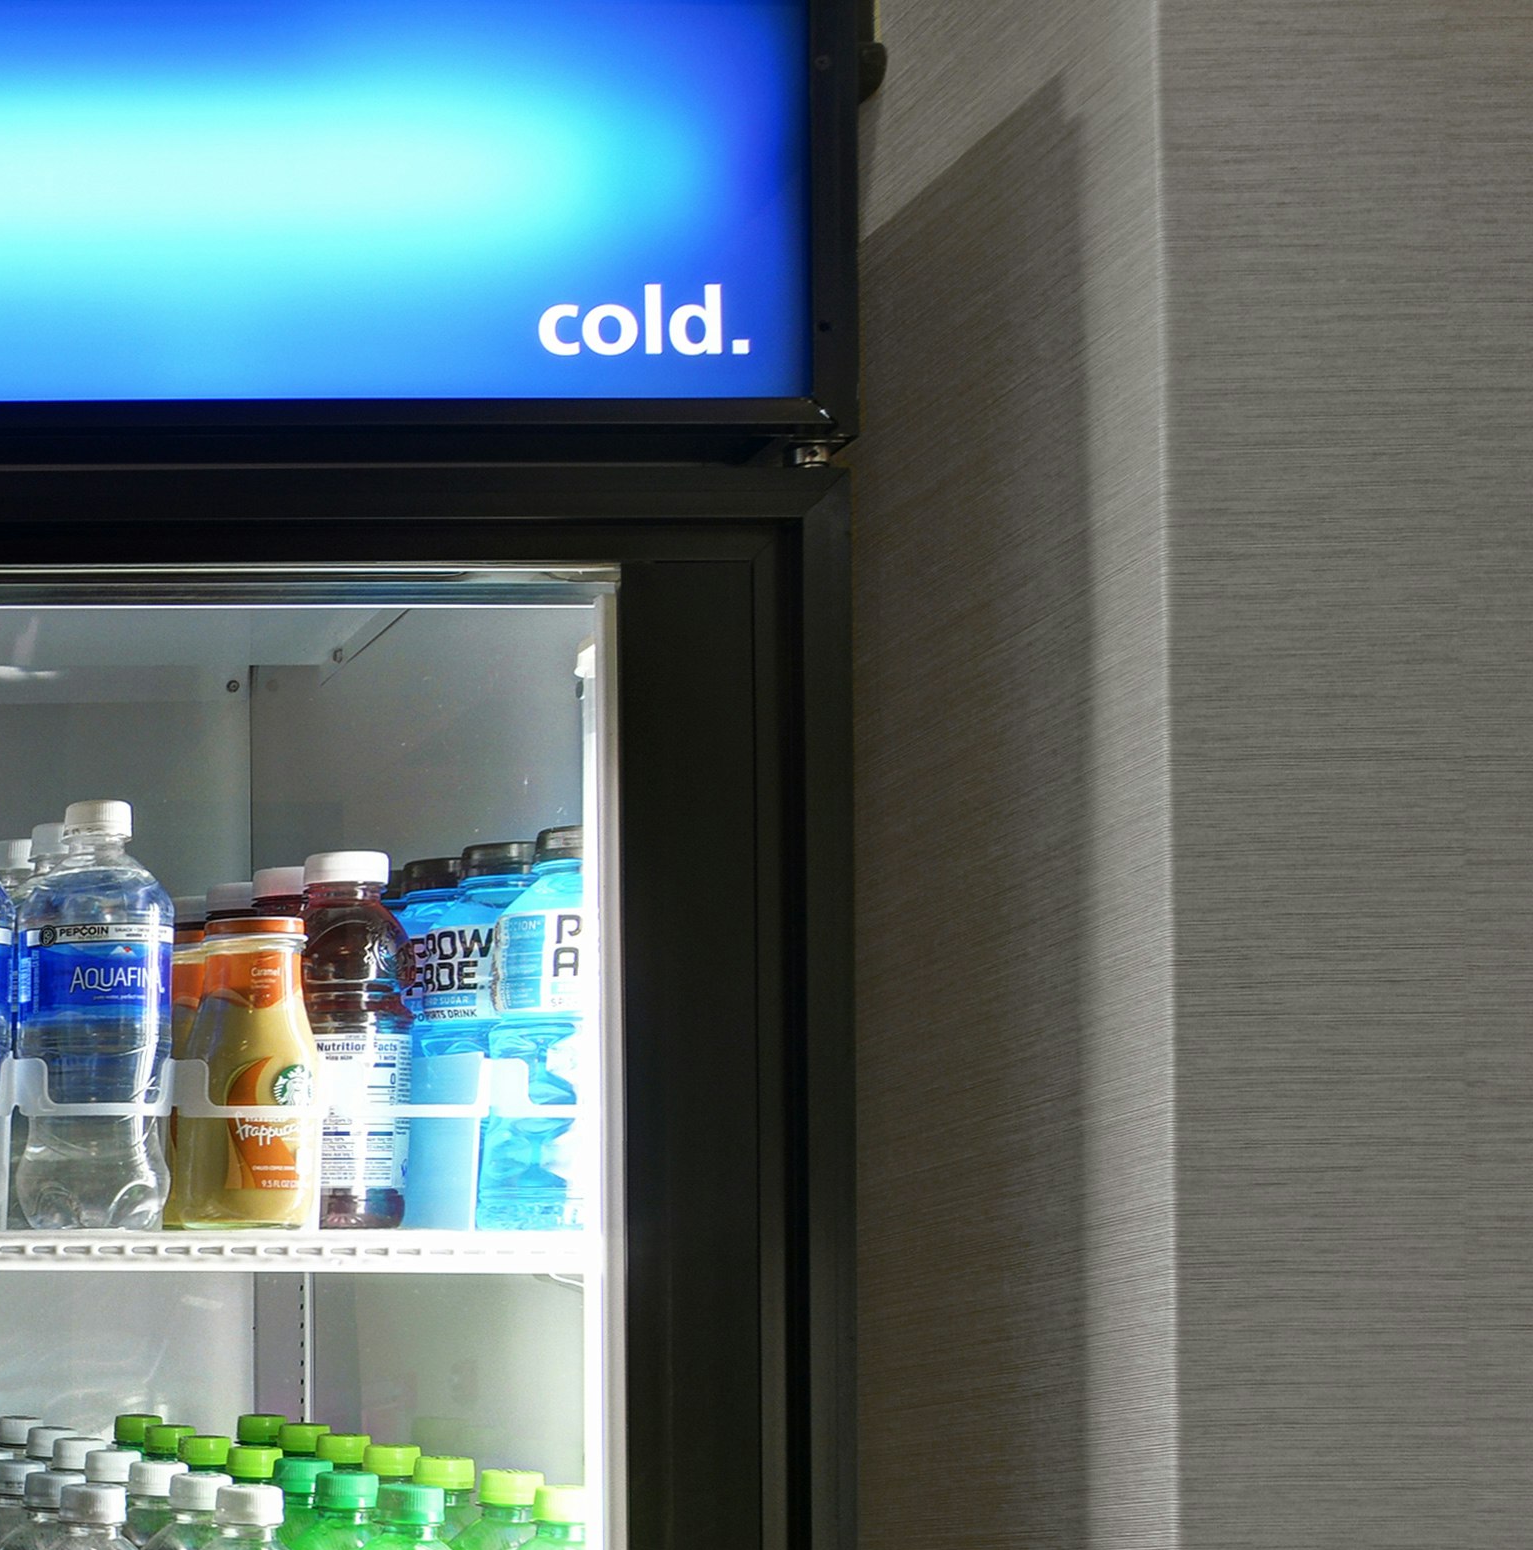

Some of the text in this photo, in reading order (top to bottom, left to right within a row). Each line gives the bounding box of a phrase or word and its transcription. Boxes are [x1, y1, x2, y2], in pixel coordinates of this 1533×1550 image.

[538, 283, 750, 356] cold.
[59, 926, 109, 938] PEPCOIN
[251, 967, 281, 978] Caramel
[70, 966, 162, 993] AQUAFINA
[440, 996, 469, 1006] SUGAR
[447, 1008, 478, 1019] DRINK
